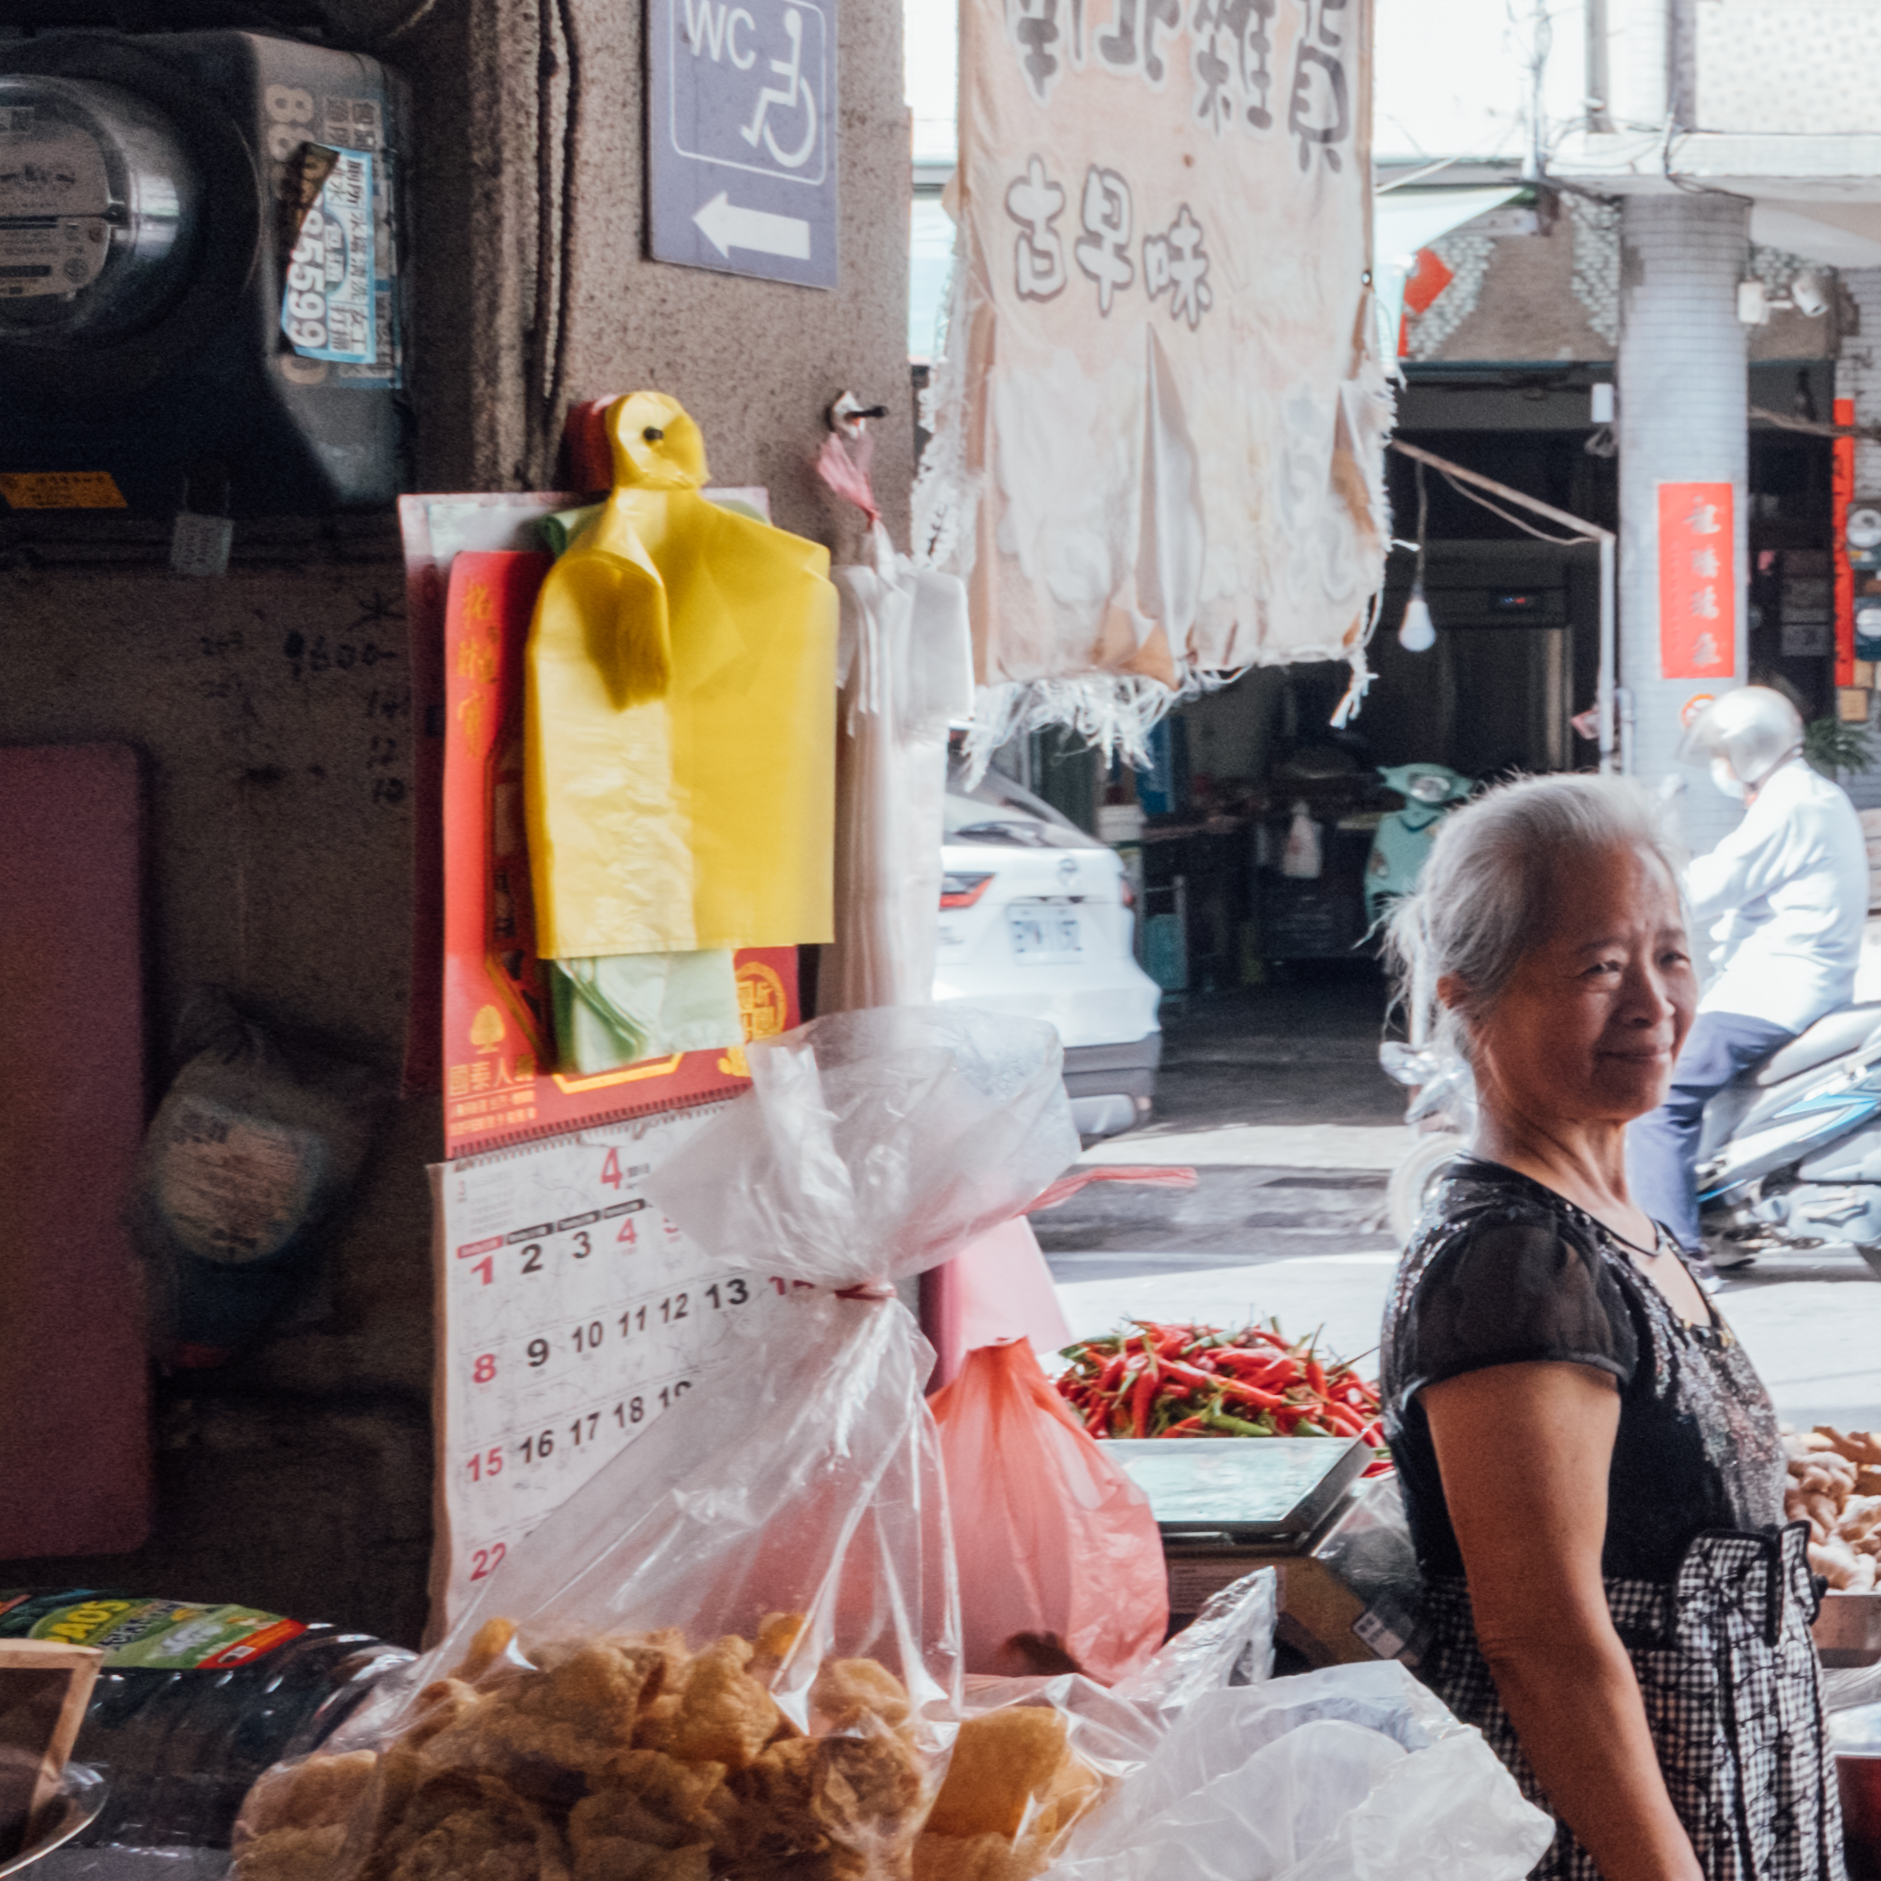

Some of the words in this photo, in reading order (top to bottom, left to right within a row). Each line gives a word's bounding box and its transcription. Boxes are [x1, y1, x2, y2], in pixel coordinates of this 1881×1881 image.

[682, 0, 757, 70] WC
[1004, 152, 1213, 333] 古早味
[448, 1053, 535, 1098] 國泰人壽
[599, 1146, 624, 1190] 4
[469, 1255, 495, 1286] 1
[520, 1243, 544, 1275] 2
[571, 1230, 593, 1260] 3
[615, 1217, 639, 1245] 4
[472, 1353, 498, 1384] 8
[525, 1338, 551, 1369] 9
[571, 1320, 605, 1354] 10
[616, 1304, 649, 1338] 11
[658, 1292, 690, 1324] 12
[703, 1278, 751, 1310] 13
[466, 1446, 506, 1483] 15
[518, 1429, 556, 1465] 16
[568, 1412, 602, 1447] 17
[612, 1395, 647, 1427] 18
